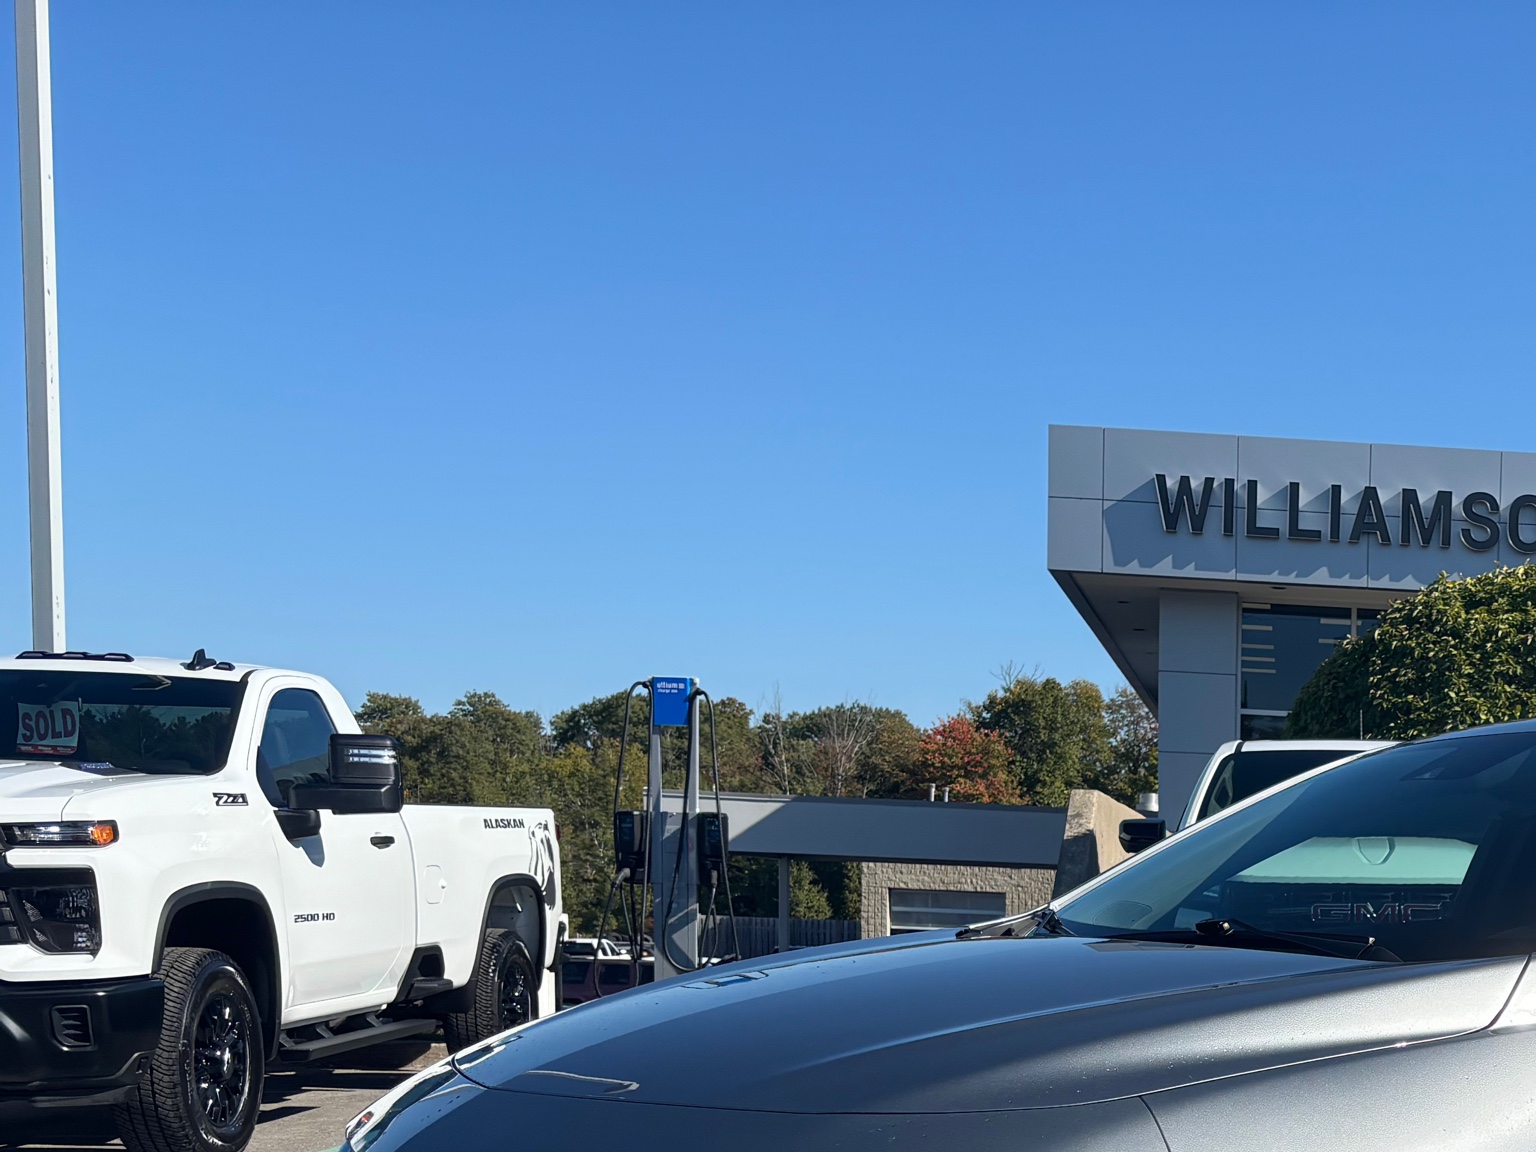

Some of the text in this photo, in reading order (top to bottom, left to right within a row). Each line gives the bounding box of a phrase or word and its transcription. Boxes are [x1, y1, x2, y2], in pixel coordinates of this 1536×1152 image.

[21, 707, 77, 743] SOLD
[483, 818, 525, 829] ALASKAN
[293, 912, 336, 924] 2500 HD
[1311, 903, 1441, 923] GMC
